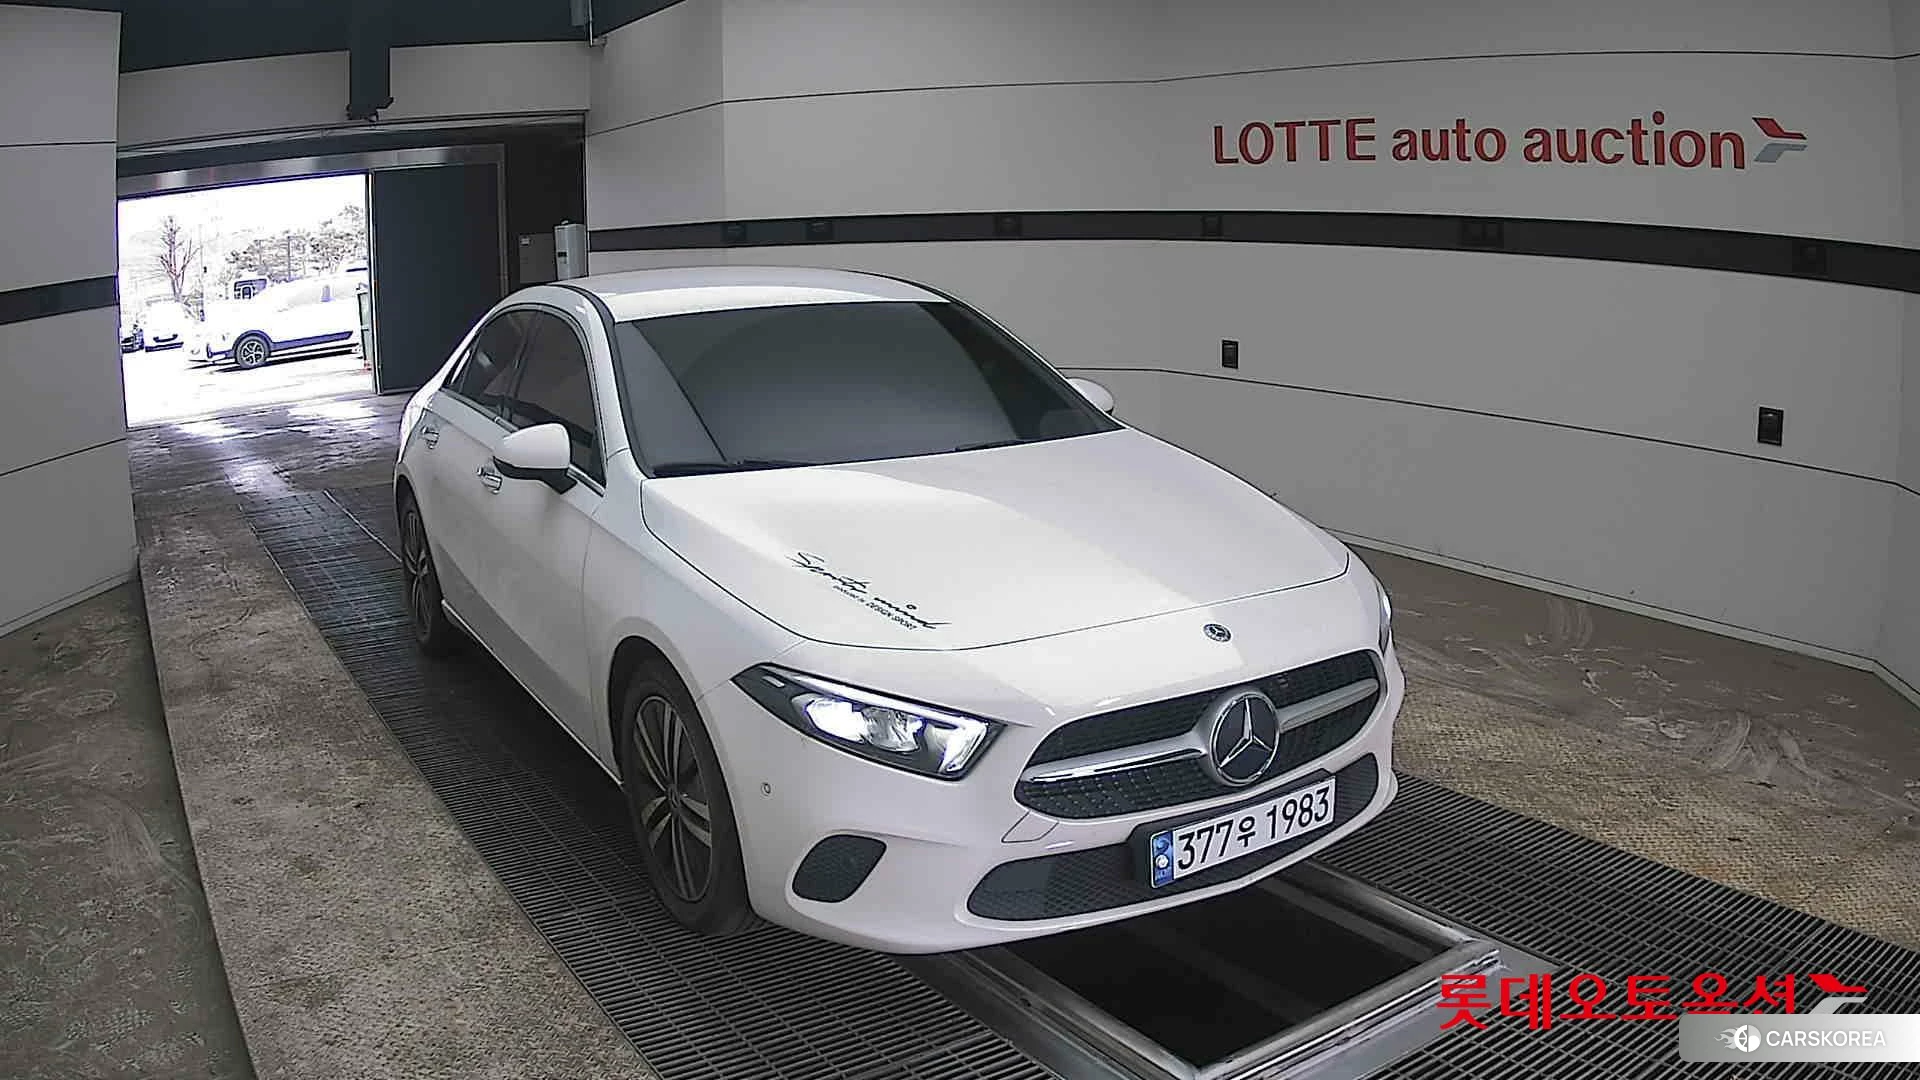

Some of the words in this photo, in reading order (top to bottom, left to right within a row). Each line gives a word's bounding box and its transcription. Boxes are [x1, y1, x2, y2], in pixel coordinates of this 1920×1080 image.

[1213, 118, 1376, 165] LOTTE
[1391, 118, 1507, 163] auto
[1522, 111, 1746, 170] auction
[1177, 816, 1256, 870] 377우
[1266, 786, 1330, 840] 1983
